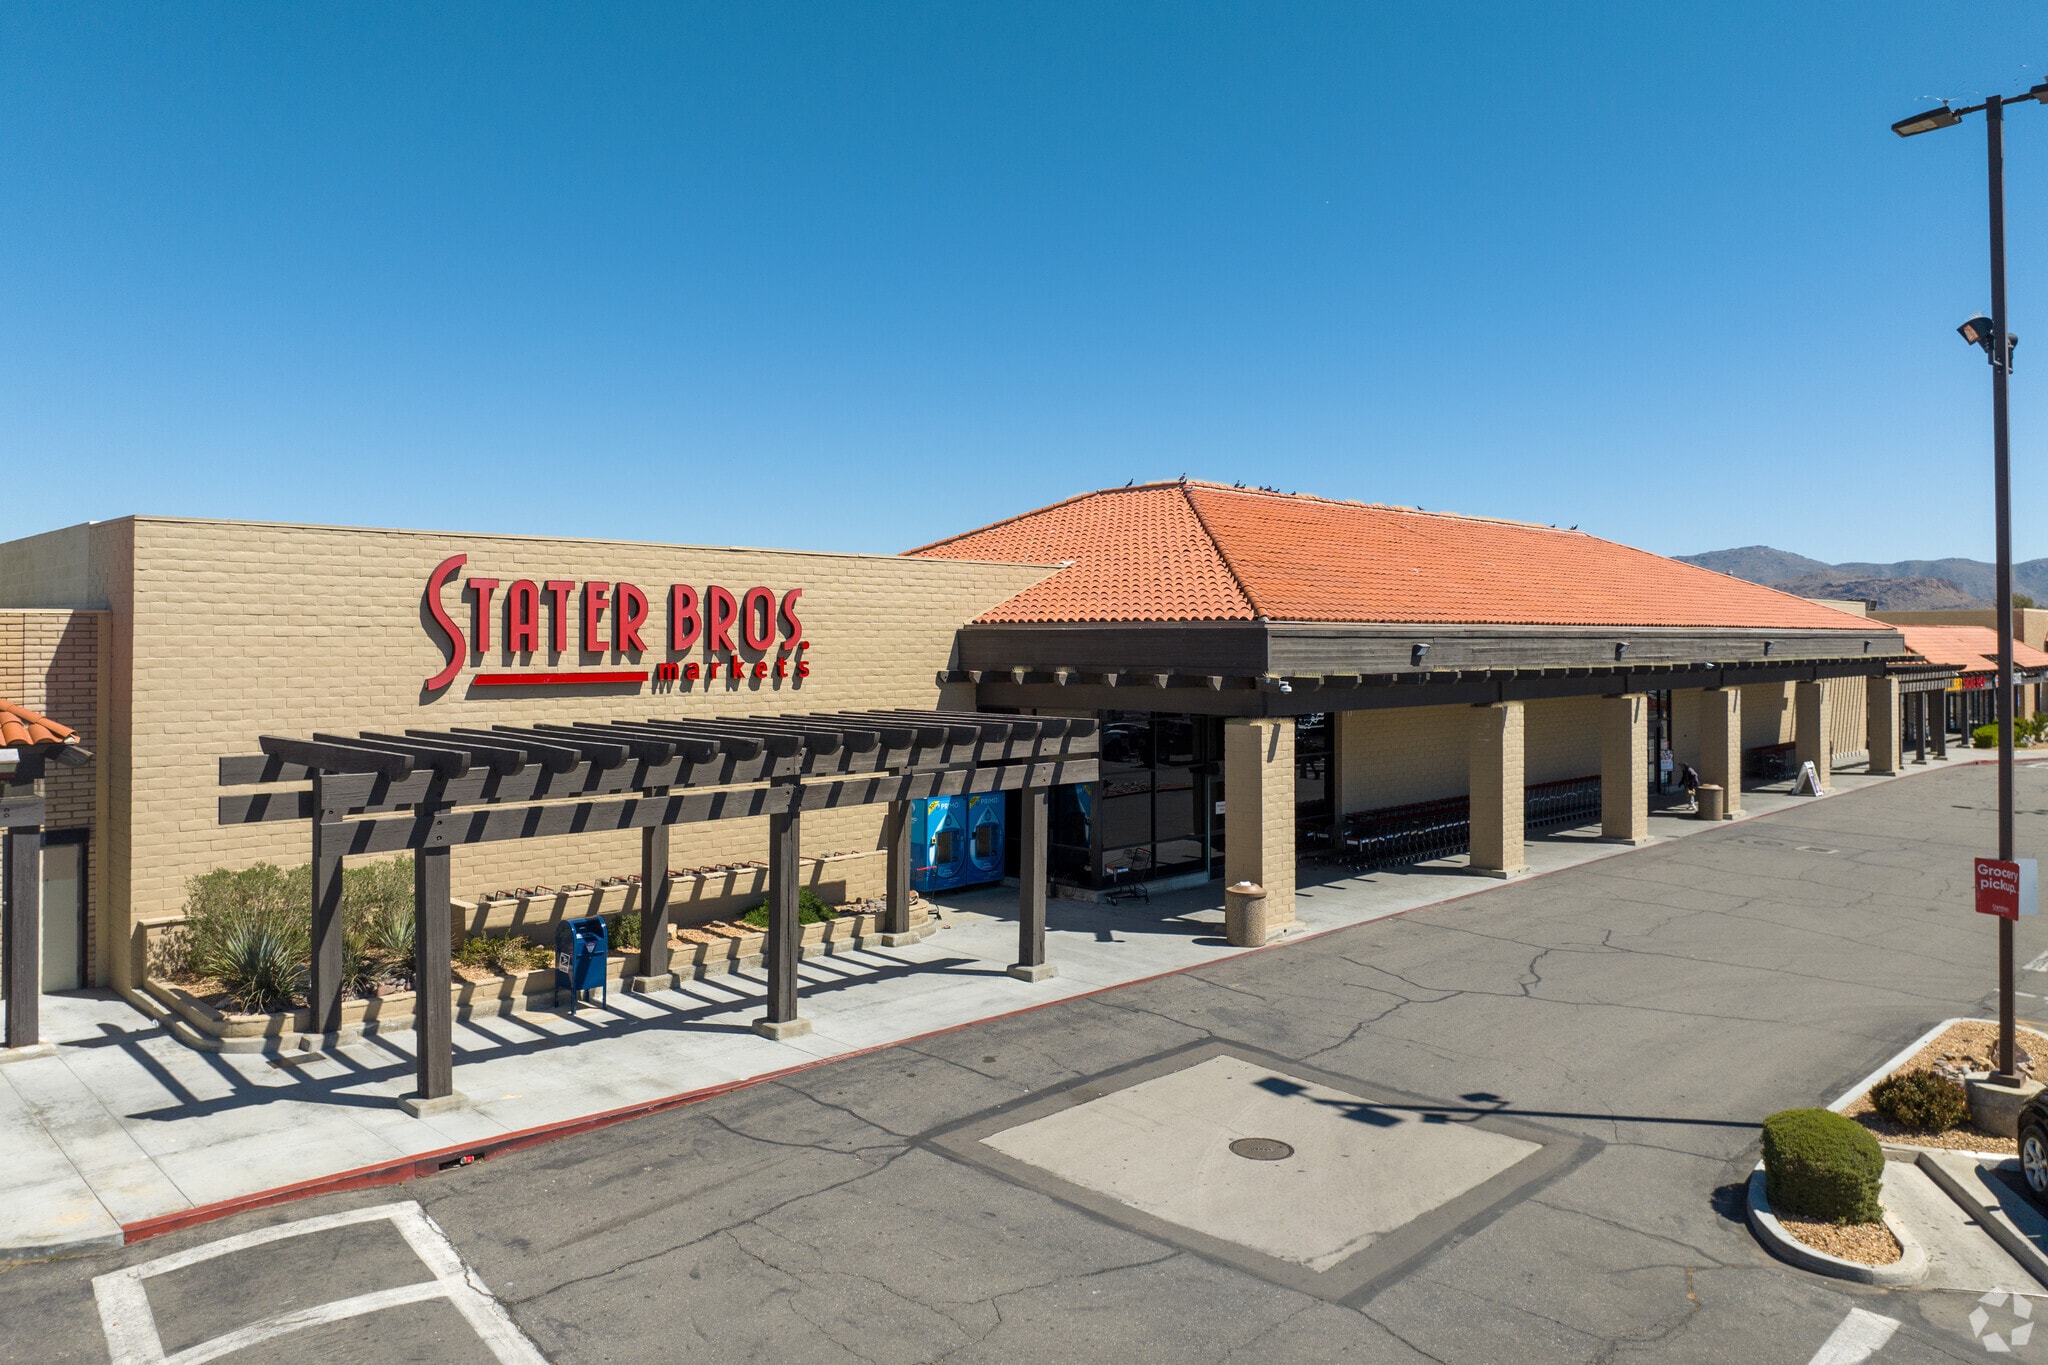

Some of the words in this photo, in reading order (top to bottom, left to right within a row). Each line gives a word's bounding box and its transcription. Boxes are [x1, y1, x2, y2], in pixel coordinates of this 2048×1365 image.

[426, 553, 649, 691] STATER
[656, 654, 810, 682] markets
[1977, 863, 2019, 883] Grocery
